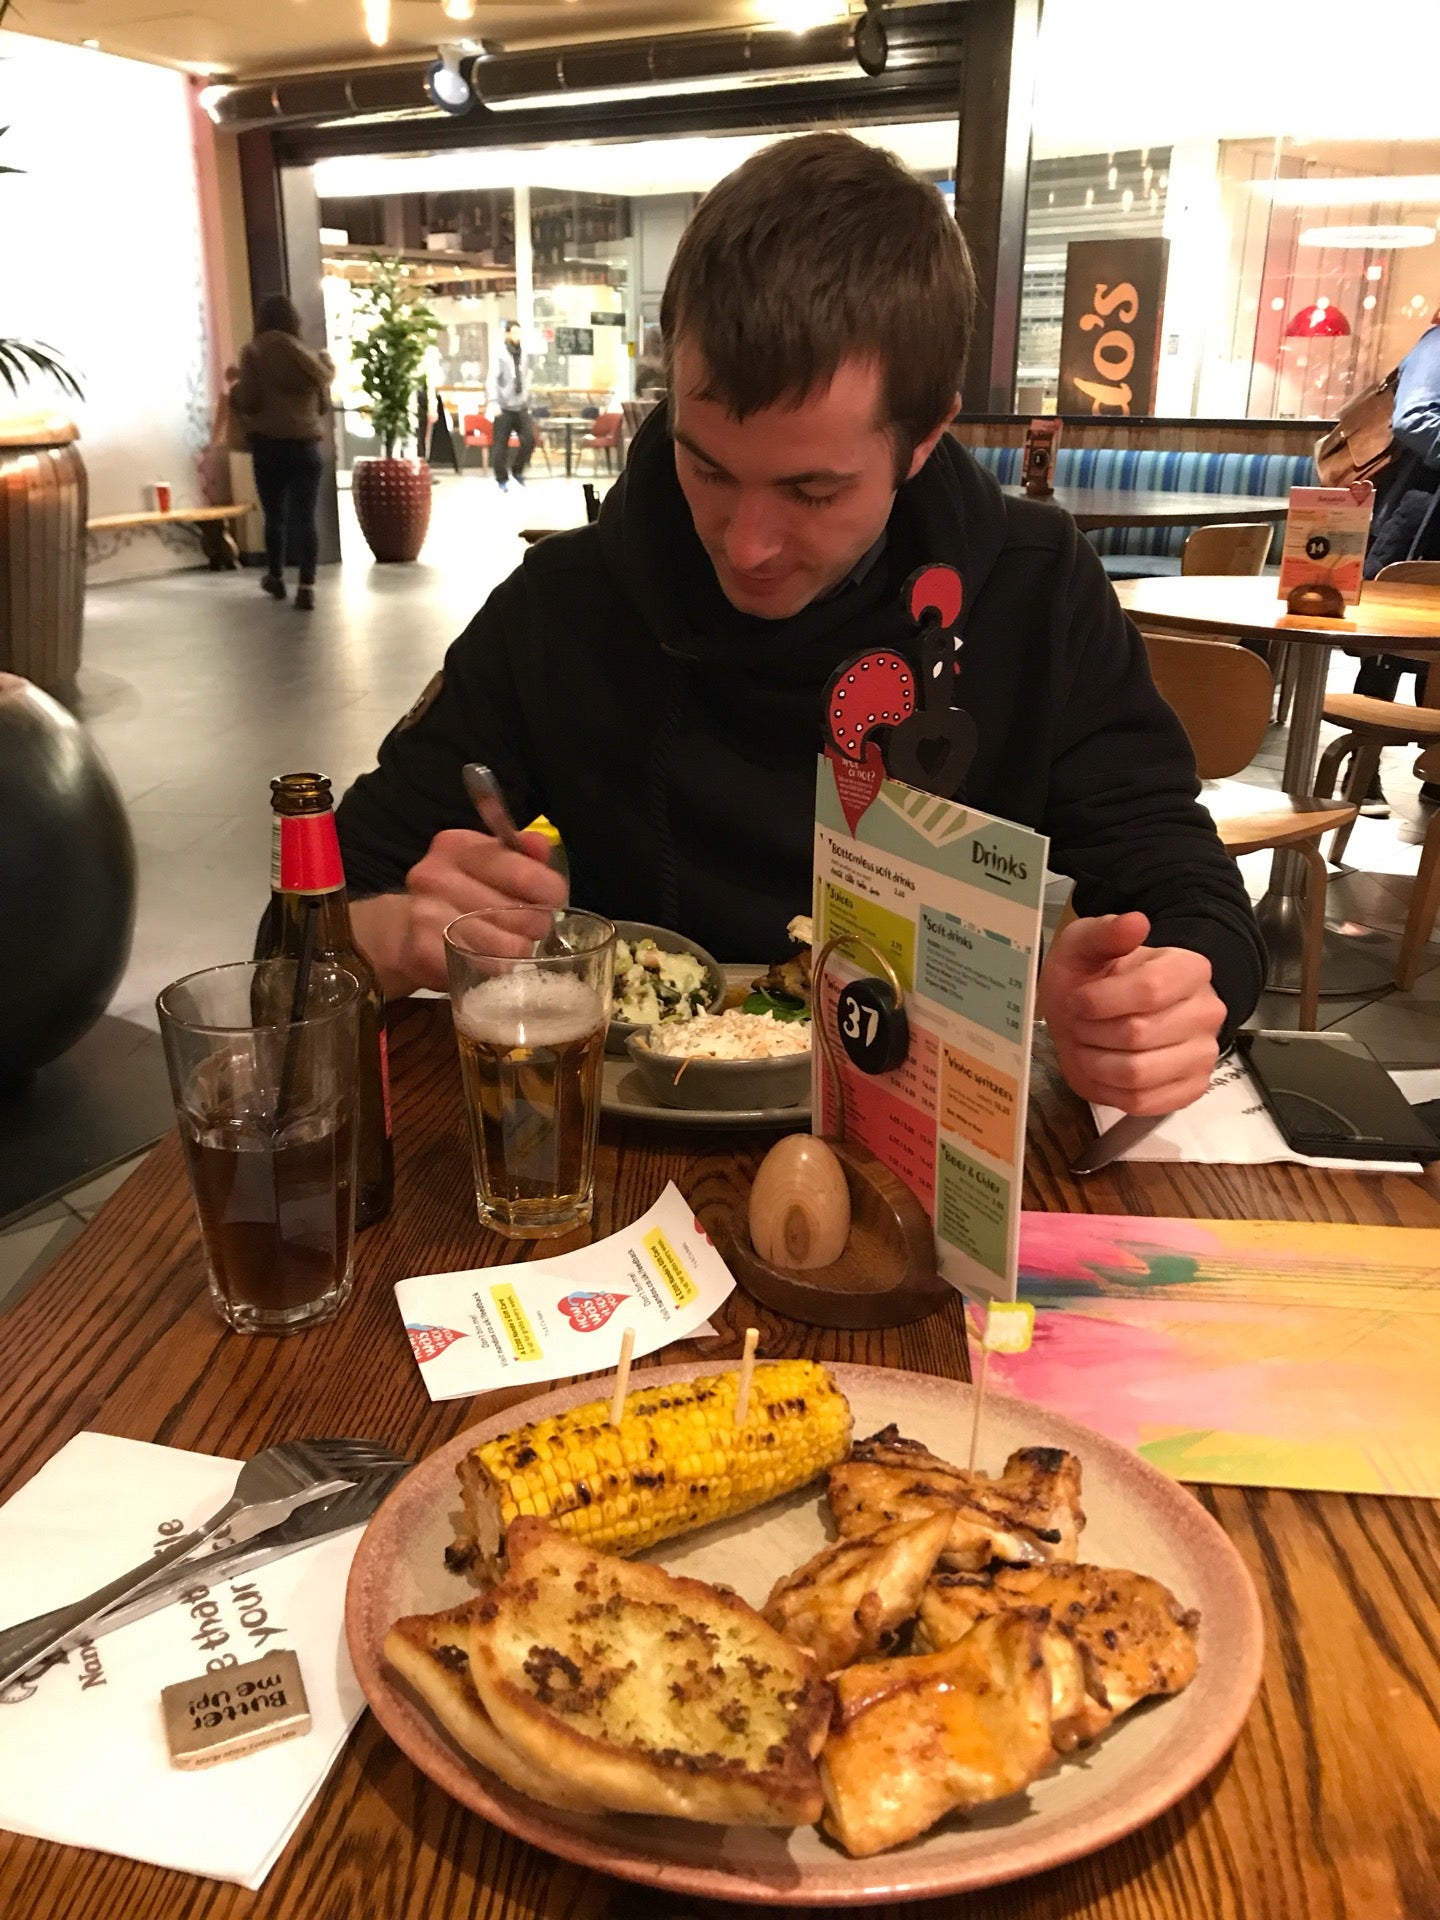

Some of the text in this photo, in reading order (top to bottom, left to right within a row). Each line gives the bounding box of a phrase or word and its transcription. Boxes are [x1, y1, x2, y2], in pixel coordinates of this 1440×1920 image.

[1309, 542, 1325, 554] 14
[831, 842, 875, 872] Bottomless
[875, 865, 892, 880] soft
[892, 871, 916, 891] drinks
[971, 840, 1028, 880] Drinks
[829, 888, 854, 909] Juices
[926, 918, 973, 950] Soft drinks
[843, 996, 879, 1048] 37
[945, 1150, 966, 1172] Beer
[976, 1171, 1000, 1194] Cider
[626, 1272, 652, 1307] Don't bin me!
[627, 1248, 671, 1322] Visit nandos.co.uk/feedback
[581, 1300, 601, 1324] was
[595, 1295, 607, 1308] for
[474, 1324, 484, 1335] bin
[477, 1333, 490, 1349] Don't
[418, 1332, 435, 1356] was
[497, 1353, 509, 1368] Visit
[231, 1582, 288, 1648] your
[236, 1674, 281, 1696] me
[190, 1690, 286, 1729] Butter
